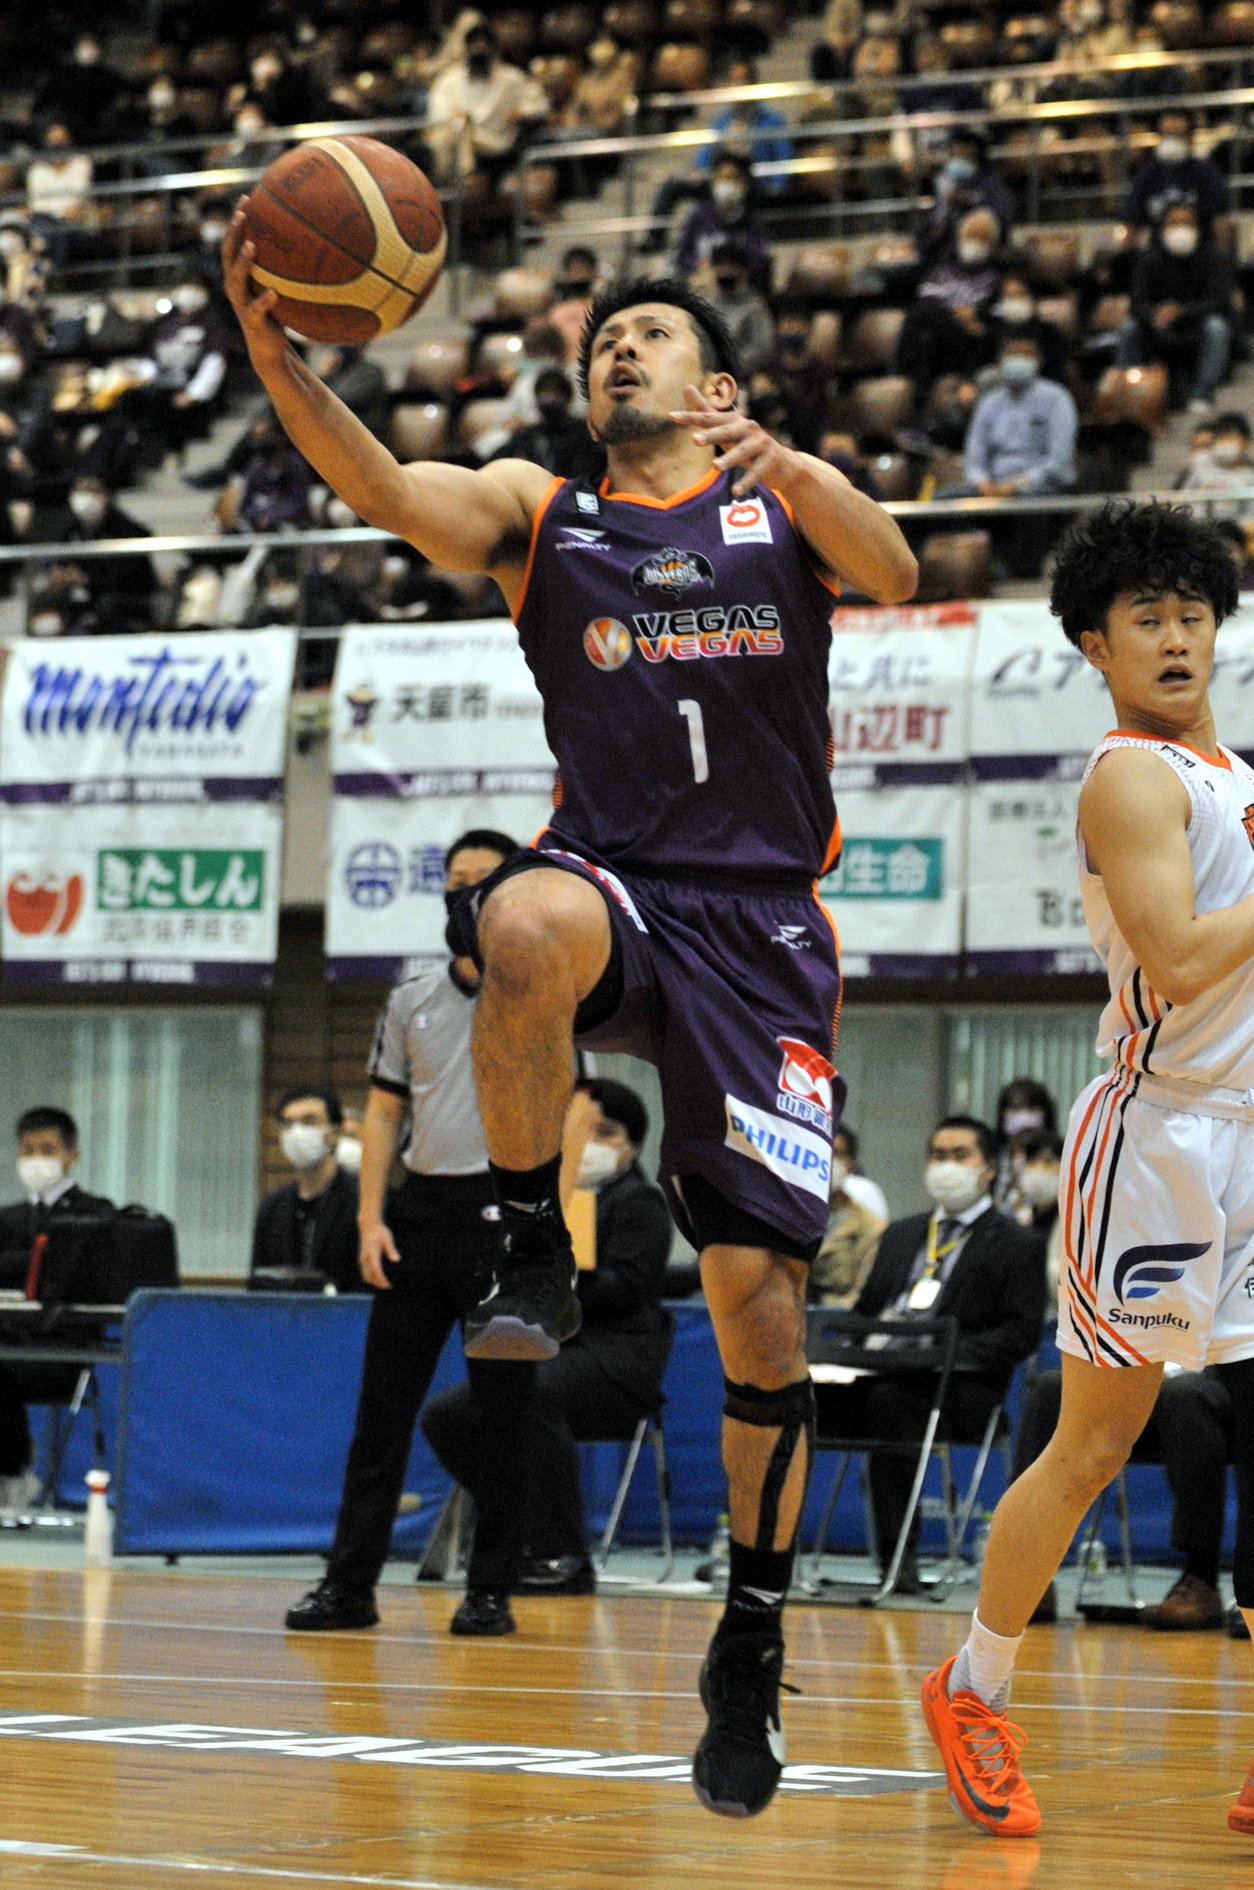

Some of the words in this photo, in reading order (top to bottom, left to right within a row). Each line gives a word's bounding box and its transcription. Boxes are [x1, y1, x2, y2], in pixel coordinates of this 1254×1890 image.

[555, 540, 612, 552] PENALTY
[632, 605, 781, 638] VEGAS
[635, 630, 785, 664] VEGAS
[677, 698, 710, 784] 1
[102, 854, 259, 908] きたしん
[729, 1112, 830, 1184] PHILIPS
[1108, 1308, 1191, 1332] Sanpuku
